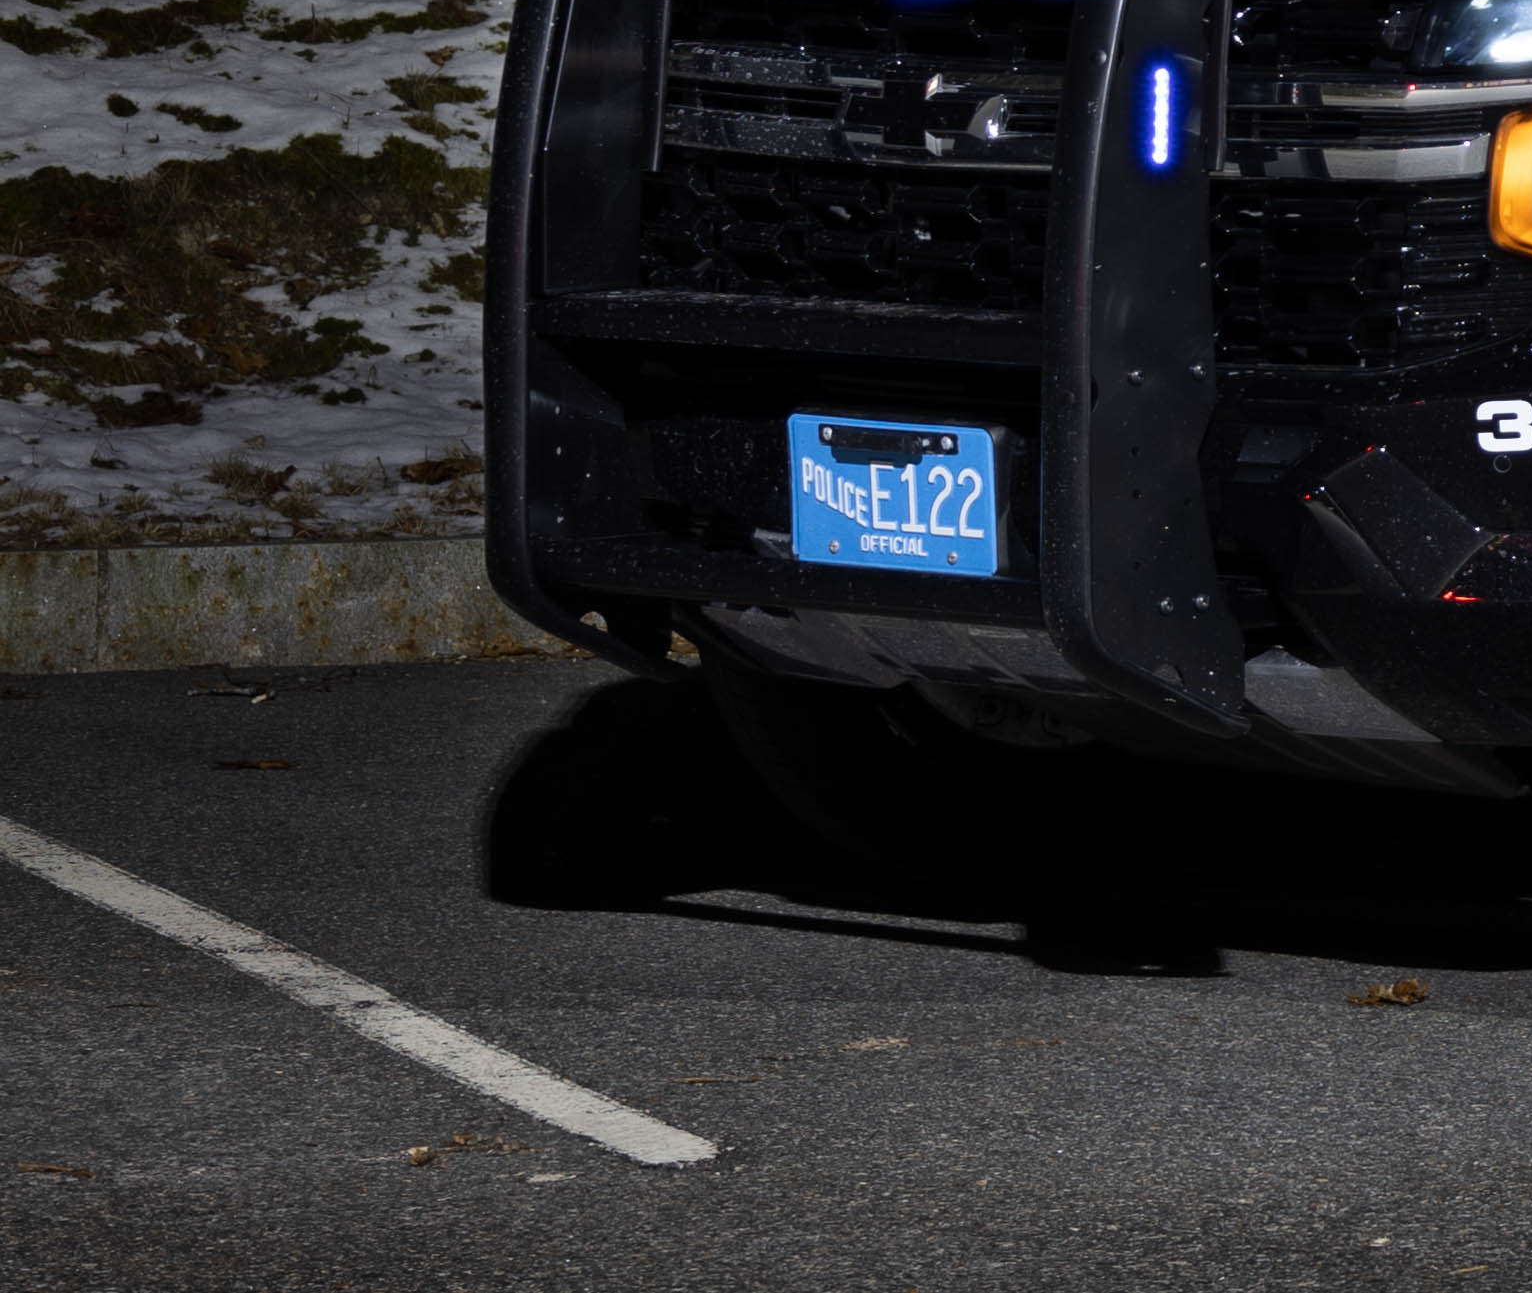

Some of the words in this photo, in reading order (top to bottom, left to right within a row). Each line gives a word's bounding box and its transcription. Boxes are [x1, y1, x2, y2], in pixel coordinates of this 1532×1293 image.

[802, 457, 869, 527] POLICE
[869, 463, 984, 538] E122
[860, 534, 928, 556] OFFICIAL
